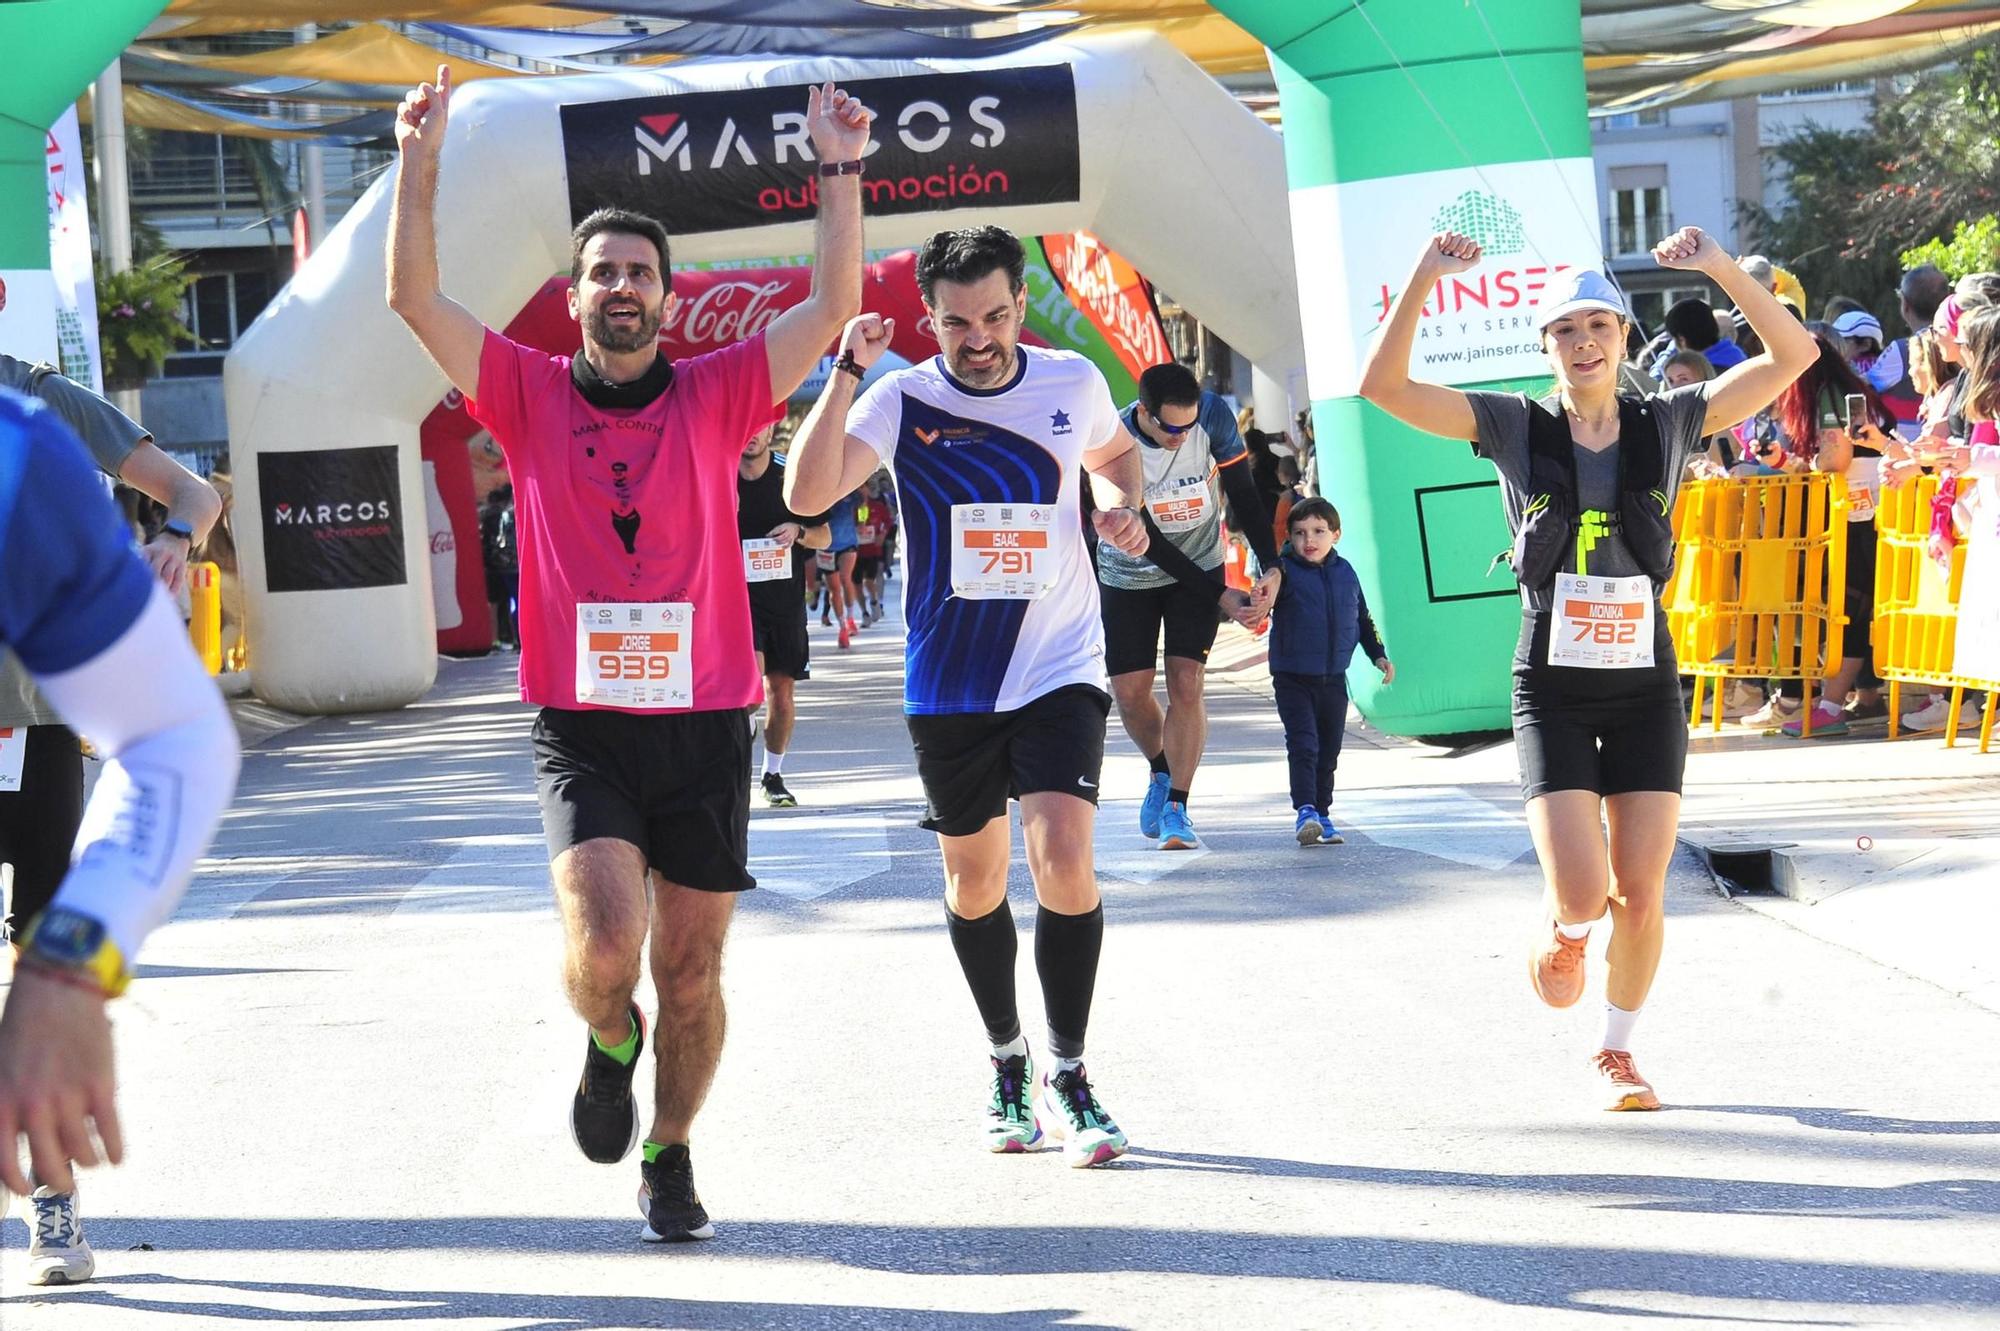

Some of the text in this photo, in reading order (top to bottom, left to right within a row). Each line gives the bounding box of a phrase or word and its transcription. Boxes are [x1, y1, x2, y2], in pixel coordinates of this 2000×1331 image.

[759, 165, 1009, 210] autmoción
[1378, 265, 1573, 322] JINSE
[1459, 323, 1468, 335] Y
[1485, 315, 1533, 332] SERV
[1424, 343, 1541, 364] www.jainser.co
[275, 501, 390, 525] MARCOS
[1160, 508, 1201, 522] 862
[993, 533, 1019, 547] ISAAC
[752, 559, 783, 570] 688
[979, 552, 1032, 574] 791
[1589, 604, 1624, 619] MONIKA
[619, 635, 651, 651] JORGE
[1571, 621, 1636, 644] 782
[598, 655, 670, 680] 939
